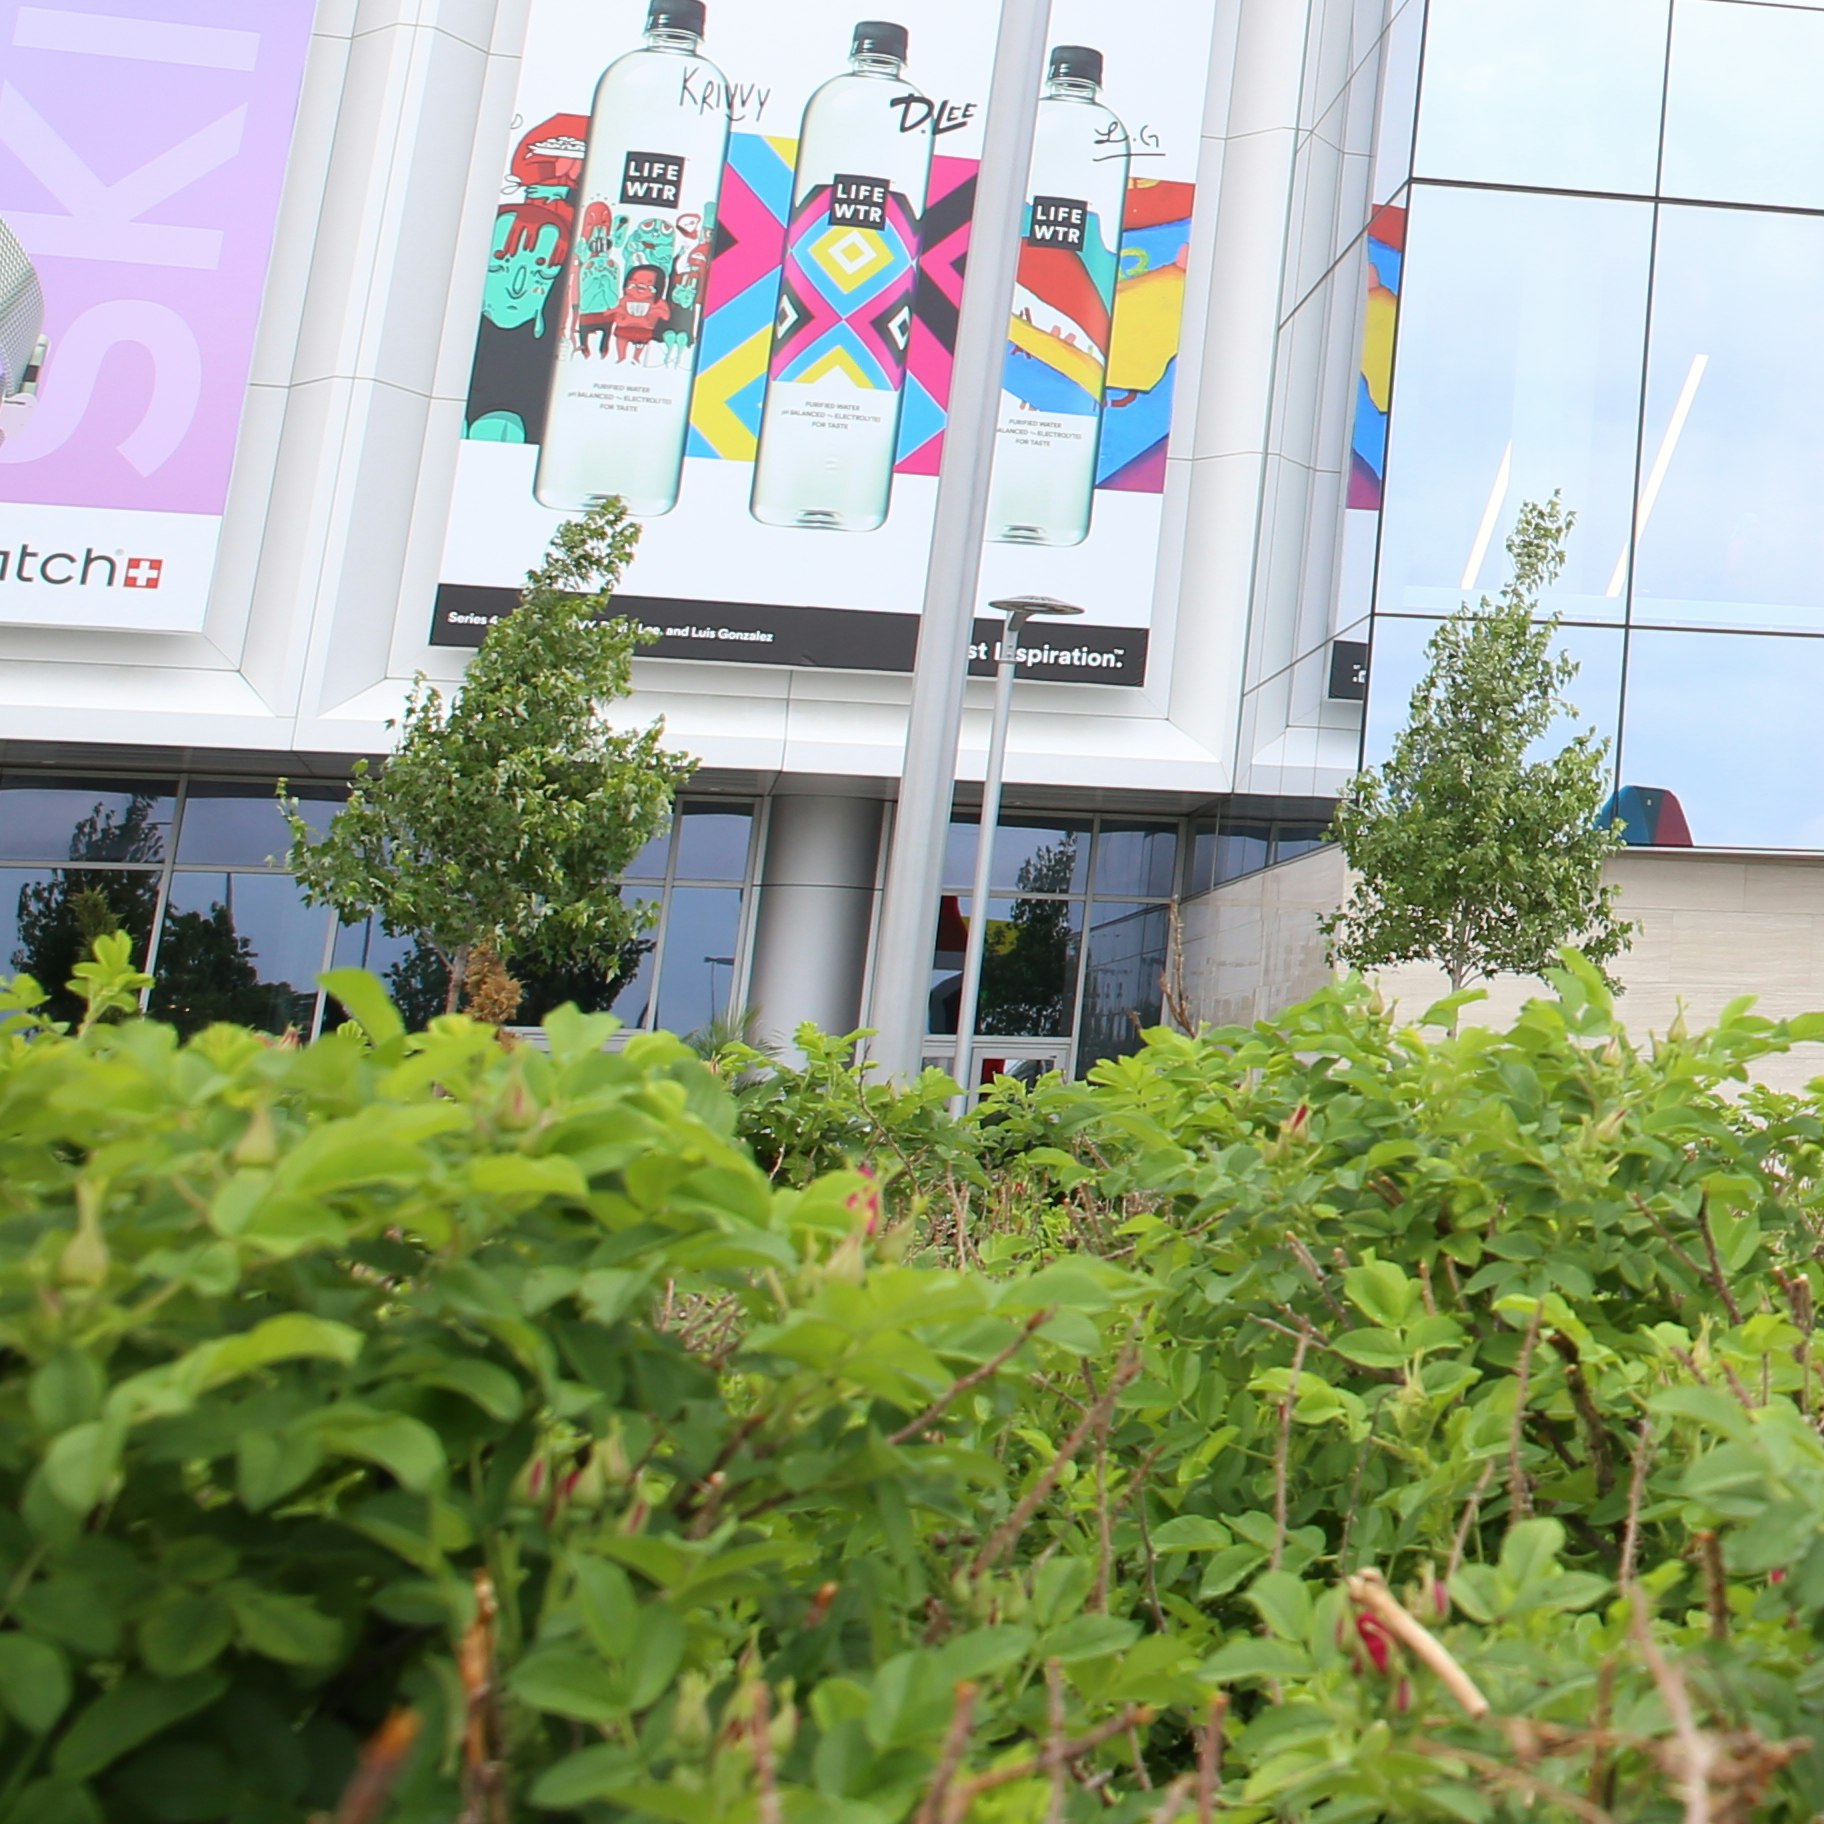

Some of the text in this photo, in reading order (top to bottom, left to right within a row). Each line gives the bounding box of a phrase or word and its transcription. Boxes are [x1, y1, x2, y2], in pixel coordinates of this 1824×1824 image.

[628, 161, 680, 181] LIFE
[625, 181, 677, 201] WTR
[835, 183, 886, 204] LIFE
[833, 203, 883, 224] WTR
[1036, 205, 1083, 224] LIFE
[1033, 224, 1081, 244] WTR
[448, 611, 488, 625] Series
[665, 625, 690, 637] and
[691, 627, 716, 639] Luis
[717, 628, 774, 643] Gonzalez
